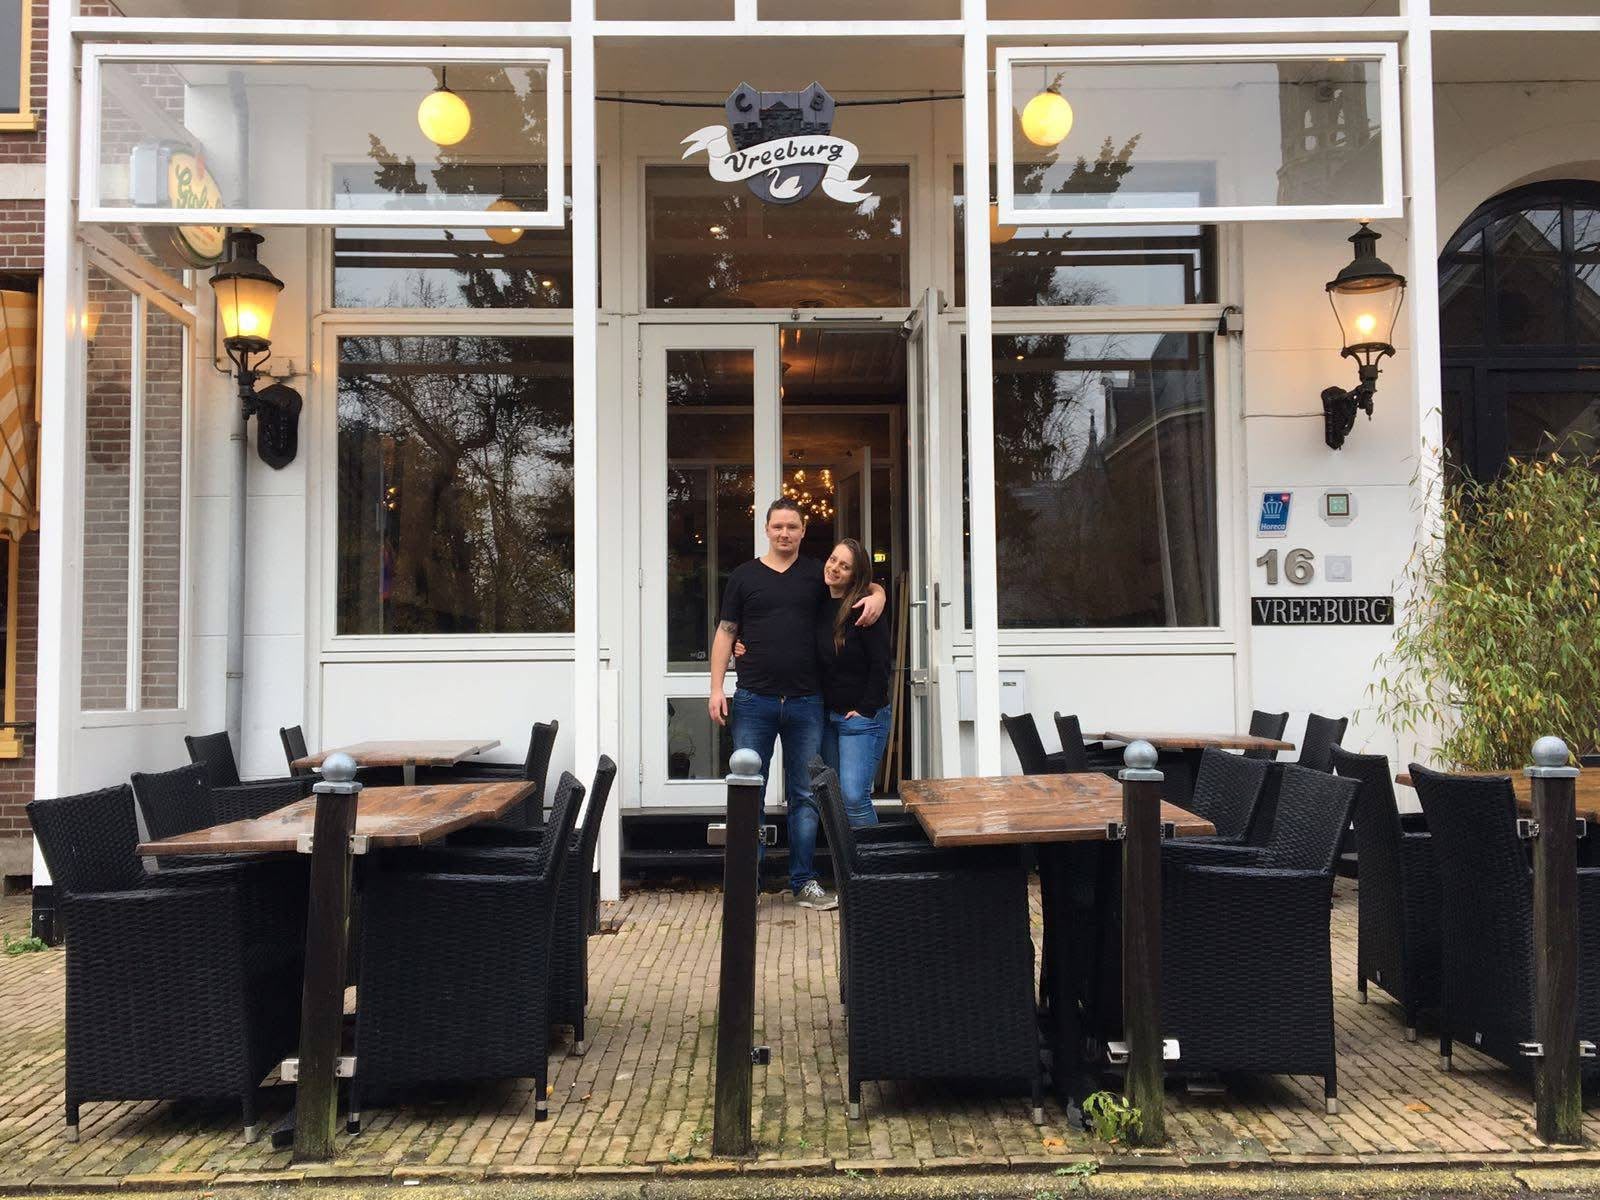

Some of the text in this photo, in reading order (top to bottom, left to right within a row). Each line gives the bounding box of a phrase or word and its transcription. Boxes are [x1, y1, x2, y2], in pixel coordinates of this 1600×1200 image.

[735, 93, 752, 112] C
[724, 141, 844, 172] Vreeburg
[1261, 523, 1286, 531] Horeca
[1256, 548, 1314, 584] 16
[1256, 599, 1386, 623] VREEBURG
